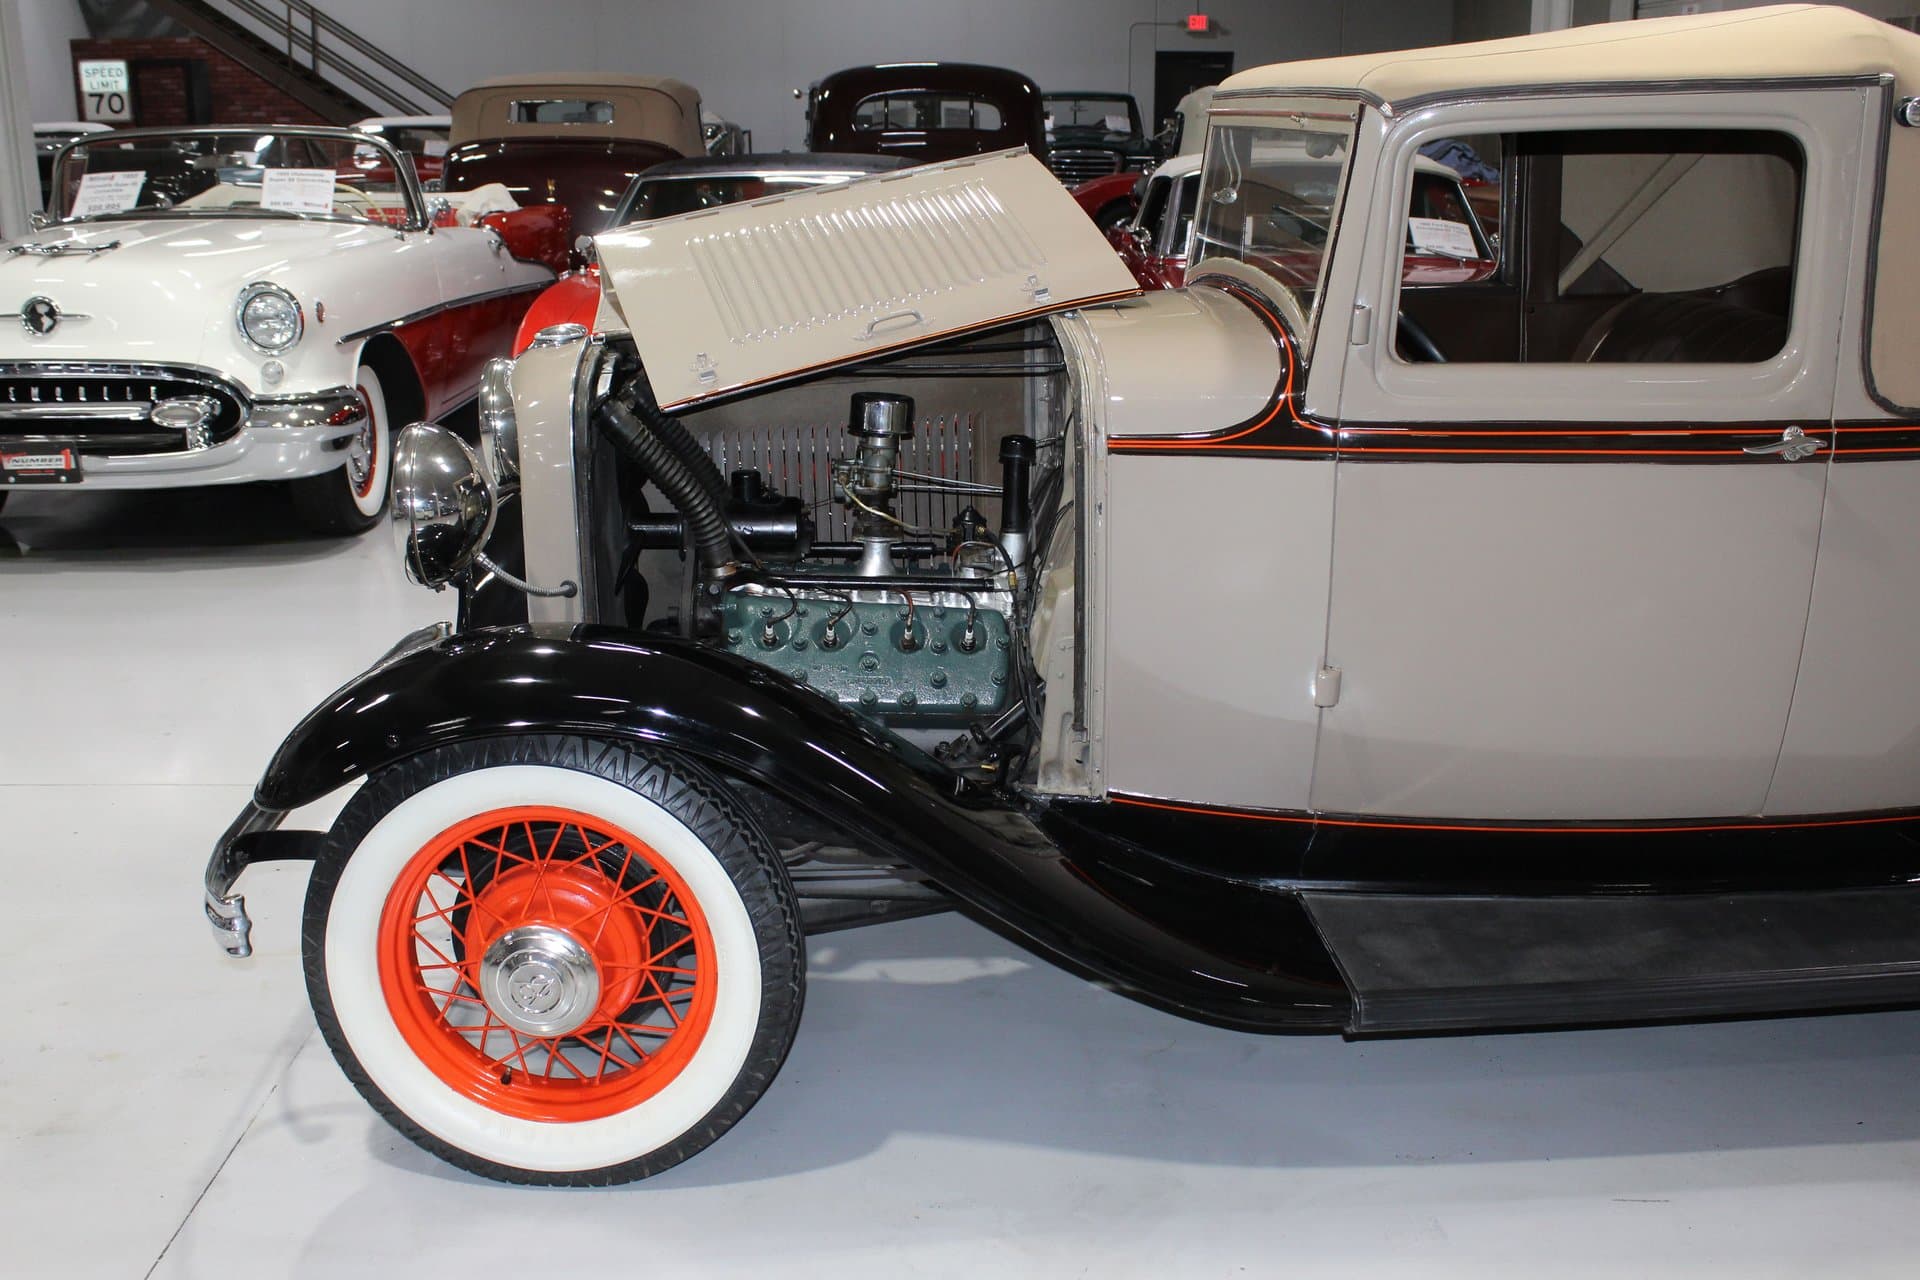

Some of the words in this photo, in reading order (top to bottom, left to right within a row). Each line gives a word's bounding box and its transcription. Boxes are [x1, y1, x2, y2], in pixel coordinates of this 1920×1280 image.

[84, 67, 123, 78] SPEED
[90, 80, 119, 90] LIMIT
[88, 92, 125, 115] 70
